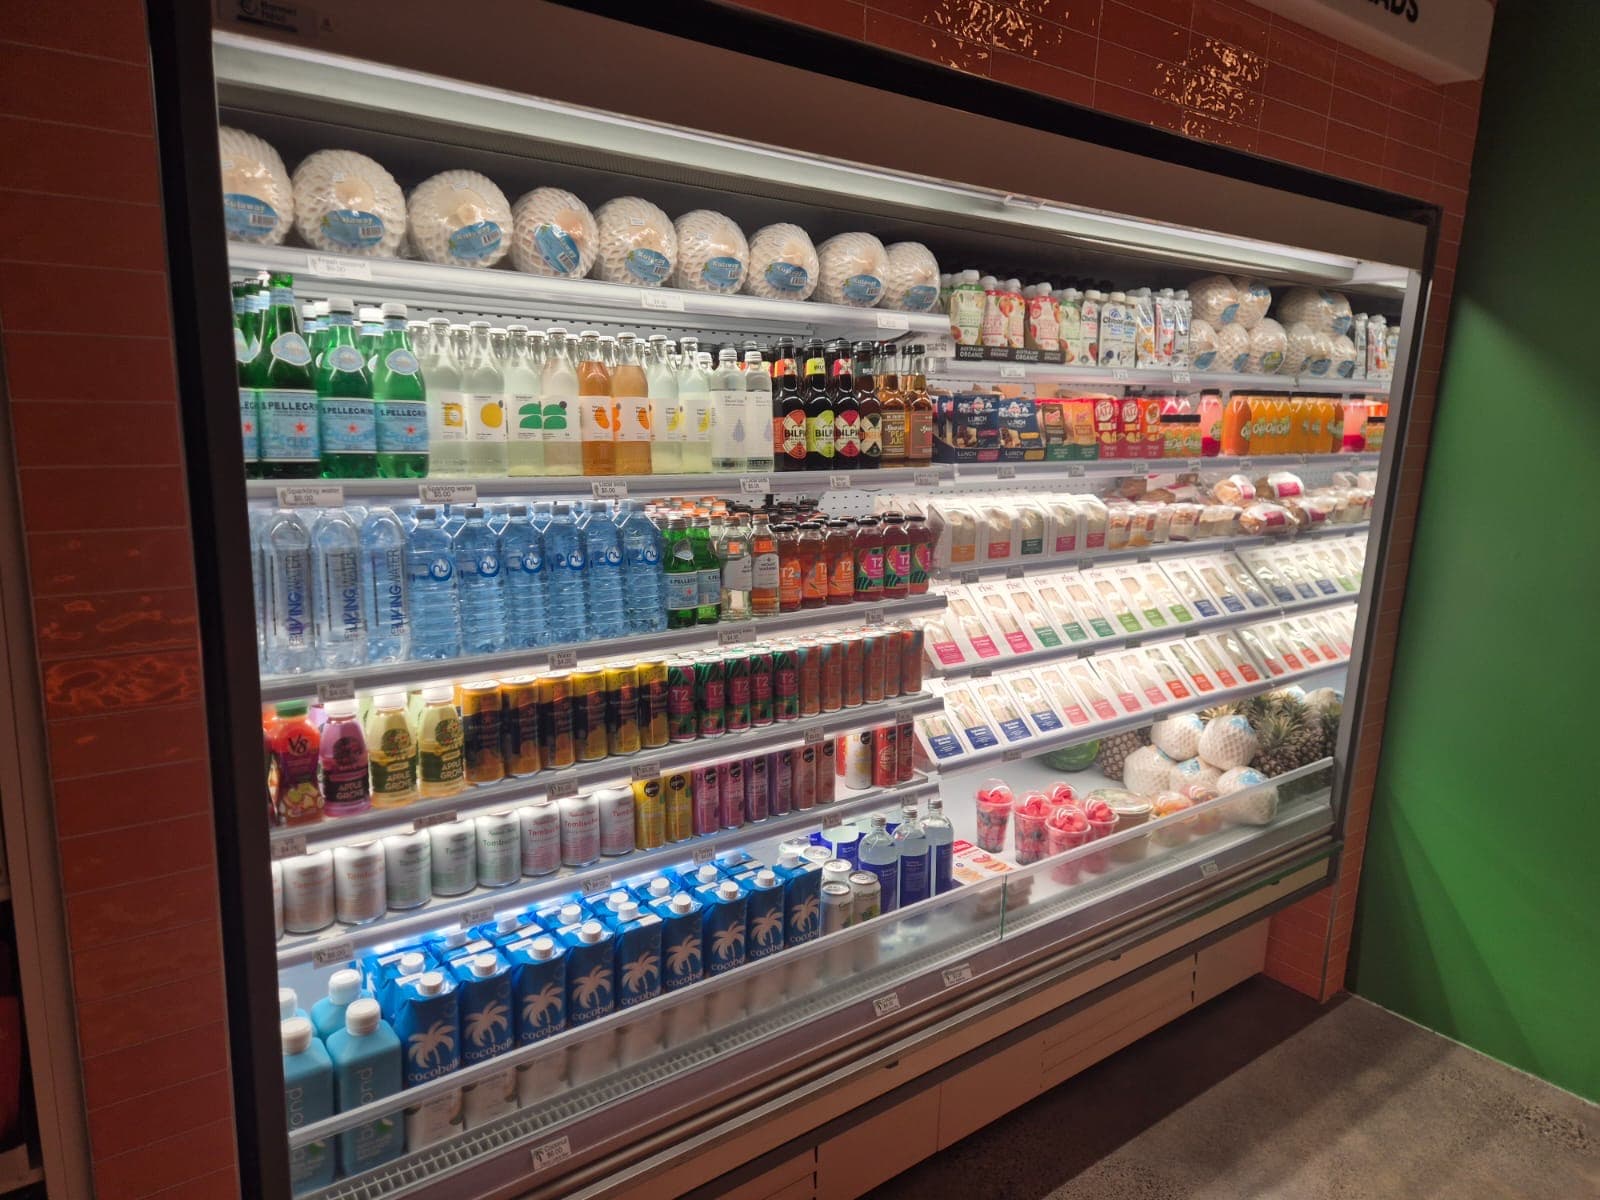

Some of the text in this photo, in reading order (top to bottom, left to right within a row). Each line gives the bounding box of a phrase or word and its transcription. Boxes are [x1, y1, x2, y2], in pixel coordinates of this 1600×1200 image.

[322, 407, 374, 416] S.PELLEGRIN
[380, 408, 427, 417] S.PELLEGRI
[836, 428, 859, 437] BILPI
[386, 549, 400, 582] WATER
[871, 557, 883, 568] T2
[899, 554, 909, 565] T2
[840, 561, 852, 571] T2
[780, 567, 794, 578] T2
[756, 675, 768, 687] T2
[781, 672, 794, 684] T2
[736, 680, 750, 692] T2
[672, 689, 689, 701] T2
[286, 736, 309, 754] V8
[666, 970, 703, 987] cocobel
[621, 985, 661, 1007] cocobel
[572, 999, 614, 1022] cocobell
[521, 1021, 565, 1041] cocobel
[464, 1037, 514, 1060] cocobell
[407, 1056, 461, 1083] cocobell
